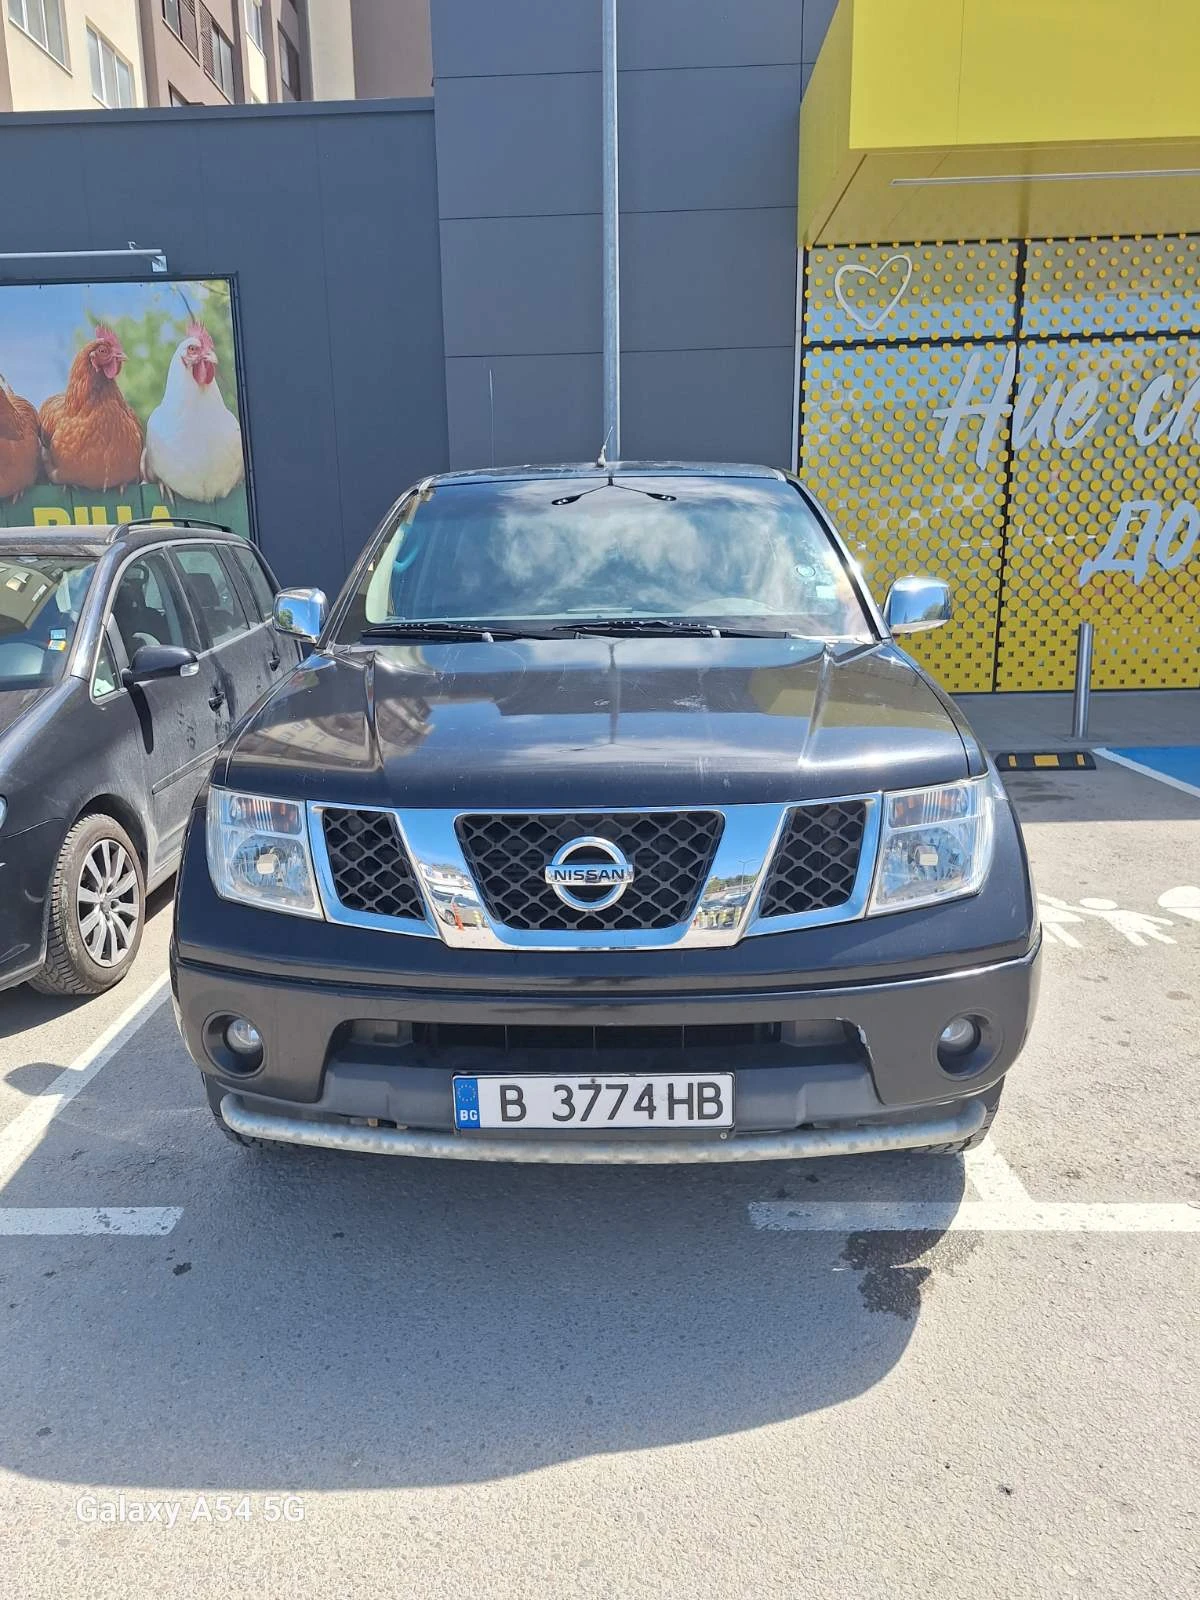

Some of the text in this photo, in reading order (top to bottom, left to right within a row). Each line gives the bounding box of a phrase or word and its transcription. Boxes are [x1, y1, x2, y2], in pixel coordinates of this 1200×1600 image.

[933, 347, 1103, 471] Ние
[553, 869, 625, 882] NISSAN
[460, 1109, 478, 1121] BG
[500, 1082, 724, 1122] B 3774 HB
